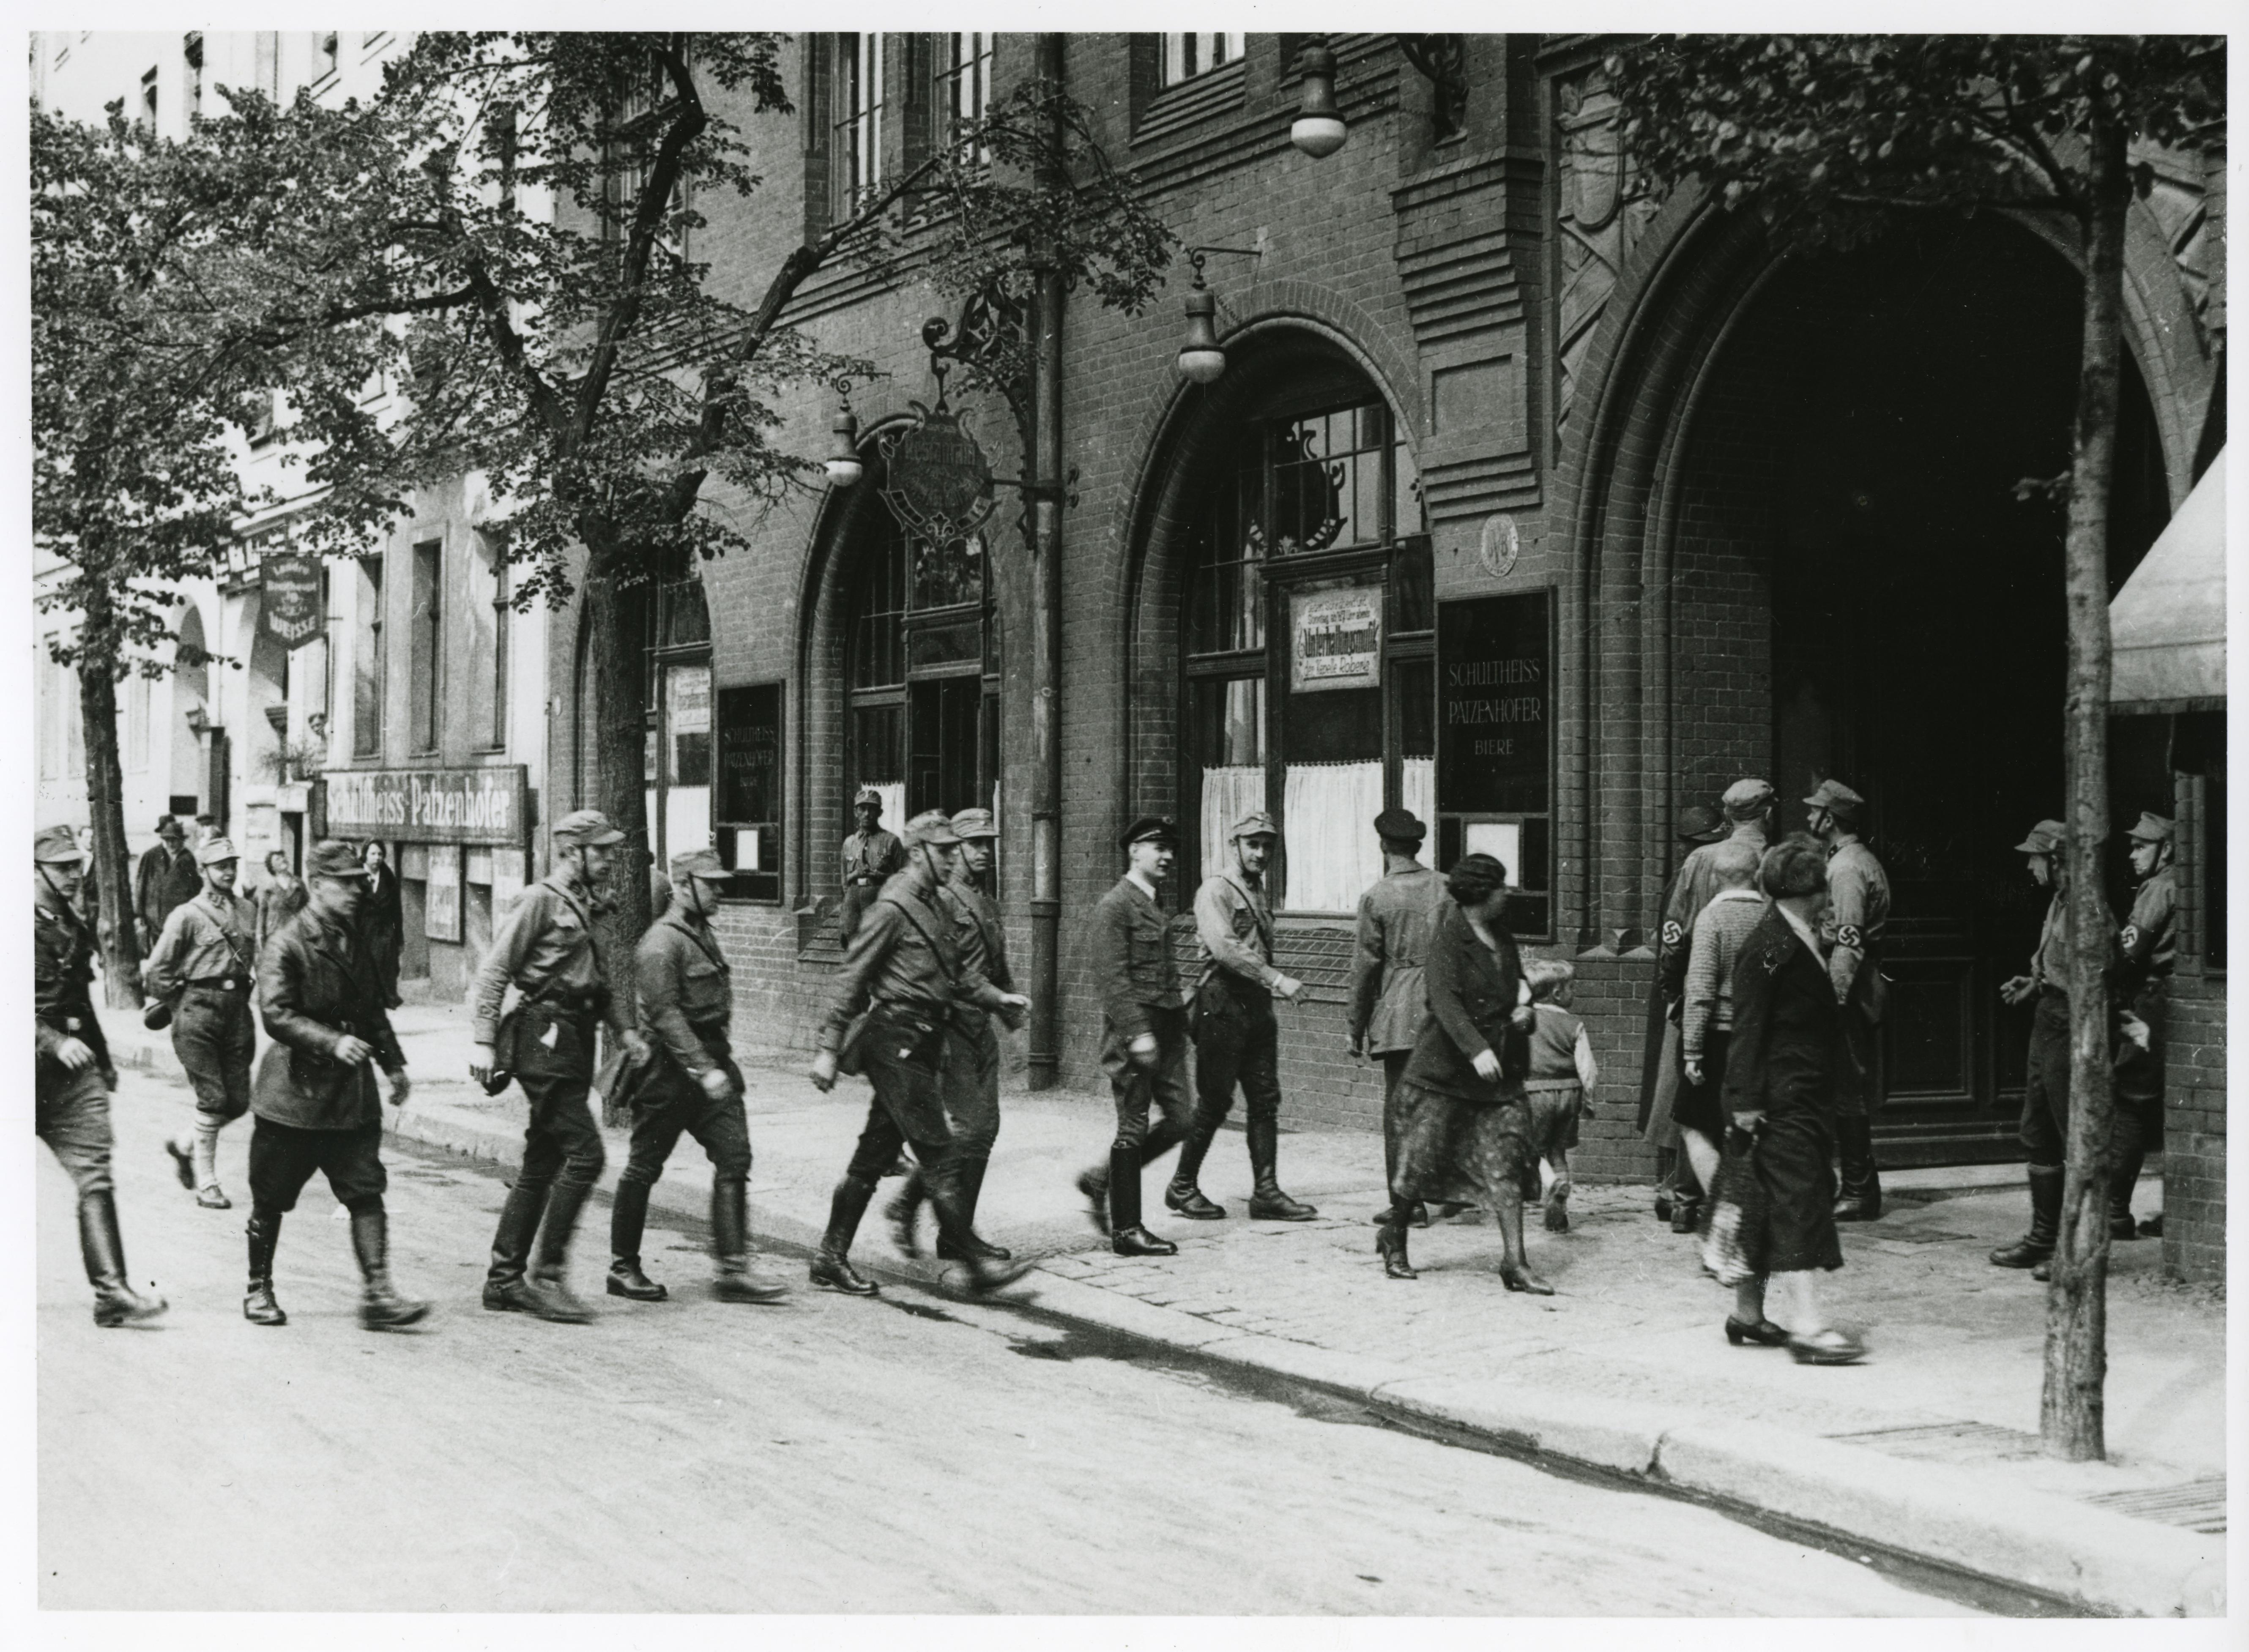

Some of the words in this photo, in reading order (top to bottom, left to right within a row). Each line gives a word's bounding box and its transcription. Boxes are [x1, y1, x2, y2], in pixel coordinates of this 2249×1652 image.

[268, 611, 316, 641] WEISSE
[1449, 659, 1540, 687] SCHULTHEISS
[1449, 697, 1541, 724] PATZENHOFER
[1475, 739, 1514, 755] BIERE
